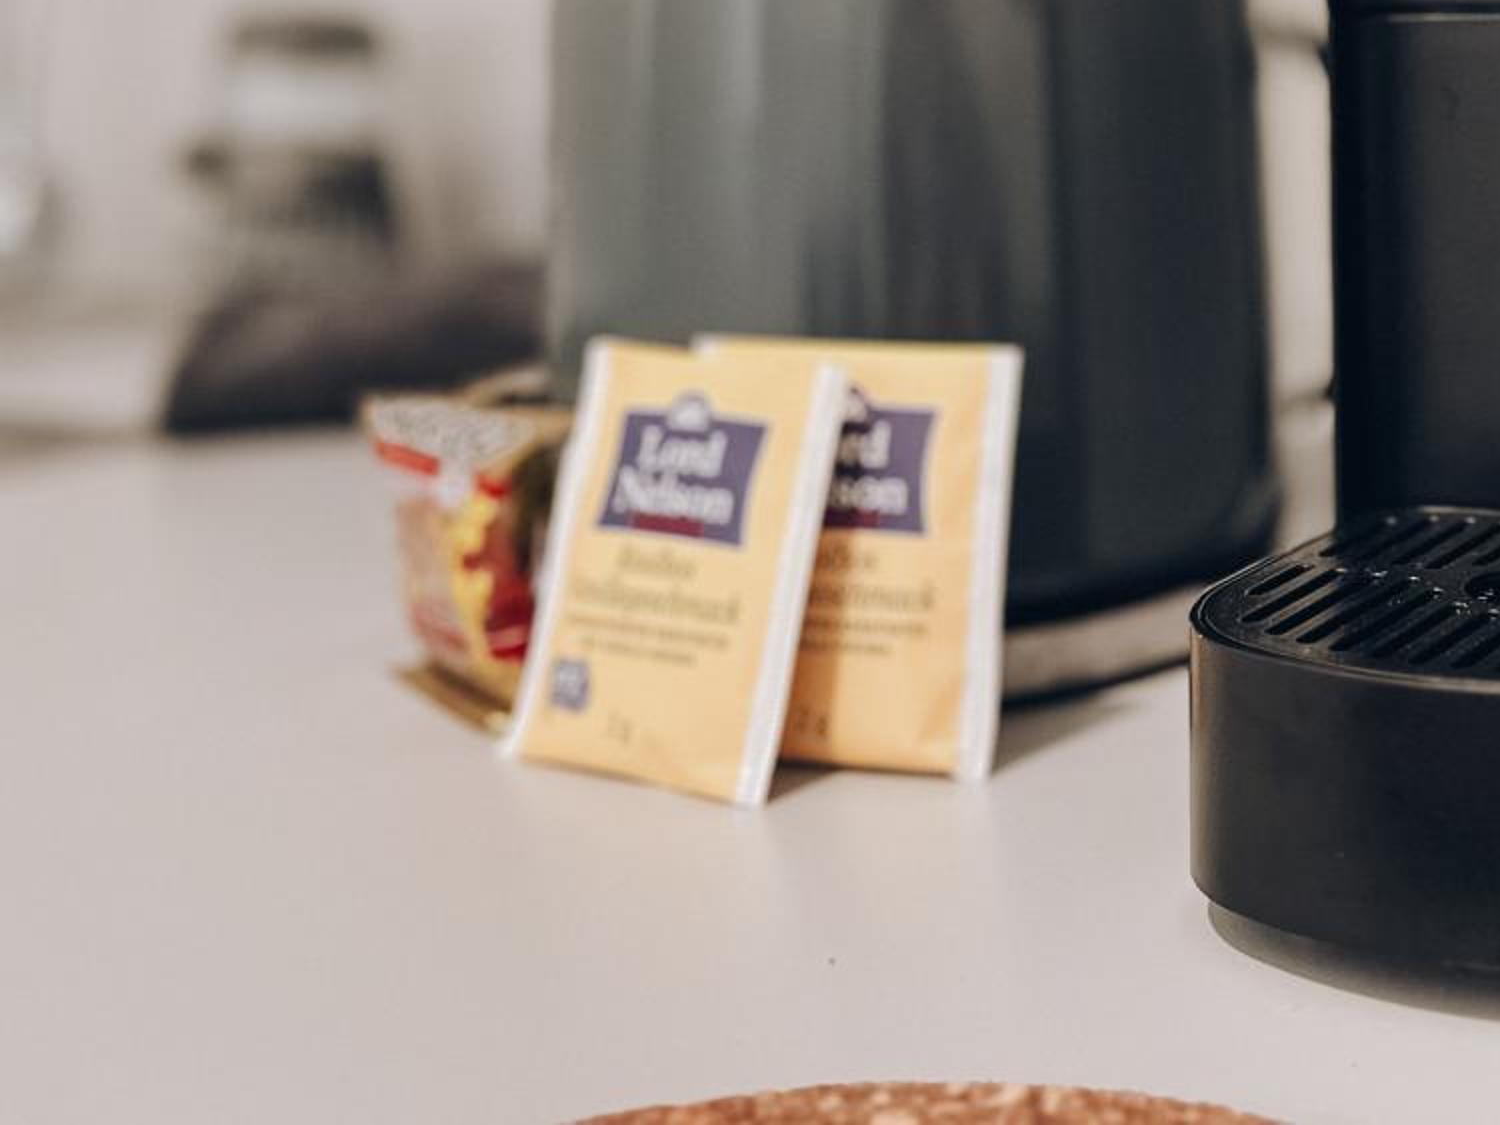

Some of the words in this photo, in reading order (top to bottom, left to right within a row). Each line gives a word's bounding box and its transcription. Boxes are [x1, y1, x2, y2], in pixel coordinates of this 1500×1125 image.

[636, 424, 728, 478] Lord
[837, 420, 892, 470] rd
[612, 463, 735, 526] Nelson
[830, 475, 909, 516] son
